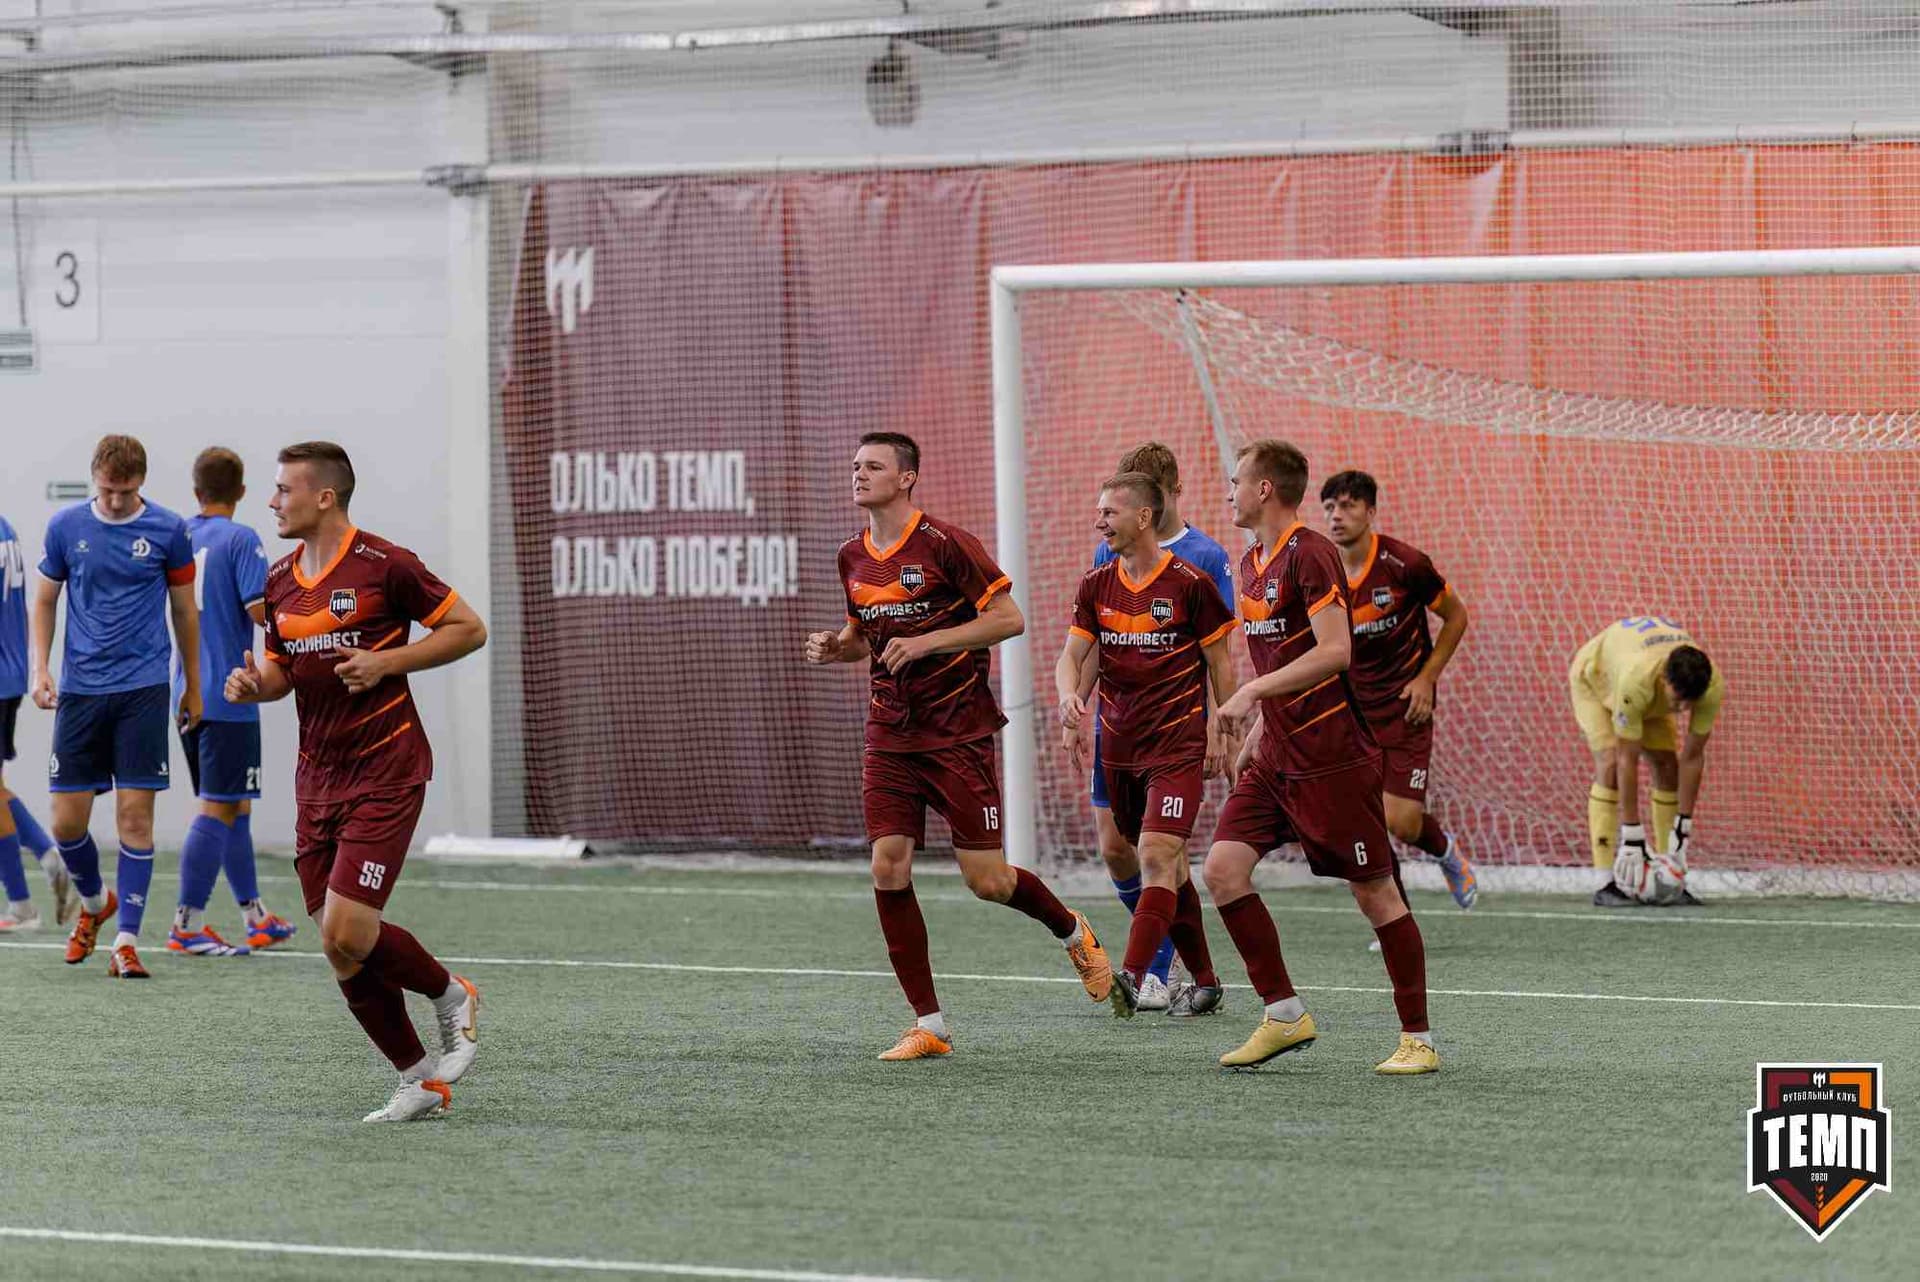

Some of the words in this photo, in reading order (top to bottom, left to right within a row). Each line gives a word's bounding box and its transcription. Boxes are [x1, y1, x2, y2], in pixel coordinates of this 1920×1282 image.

[55, 251, 80, 308] 3
[551, 452, 657, 513] ОЛЬКО
[662, 451, 756, 516] ТЕМП,
[552, 536, 657, 597] ОЛЬКО
[666, 536, 799, 606] ПОБЕДА!
[246, 767, 261, 790] 21
[1409, 768, 1427, 790] 22
[983, 806, 999, 831] 15
[1161, 796, 1184, 818] 20
[1354, 841, 1368, 866] 6
[359, 860, 386, 890] 55
